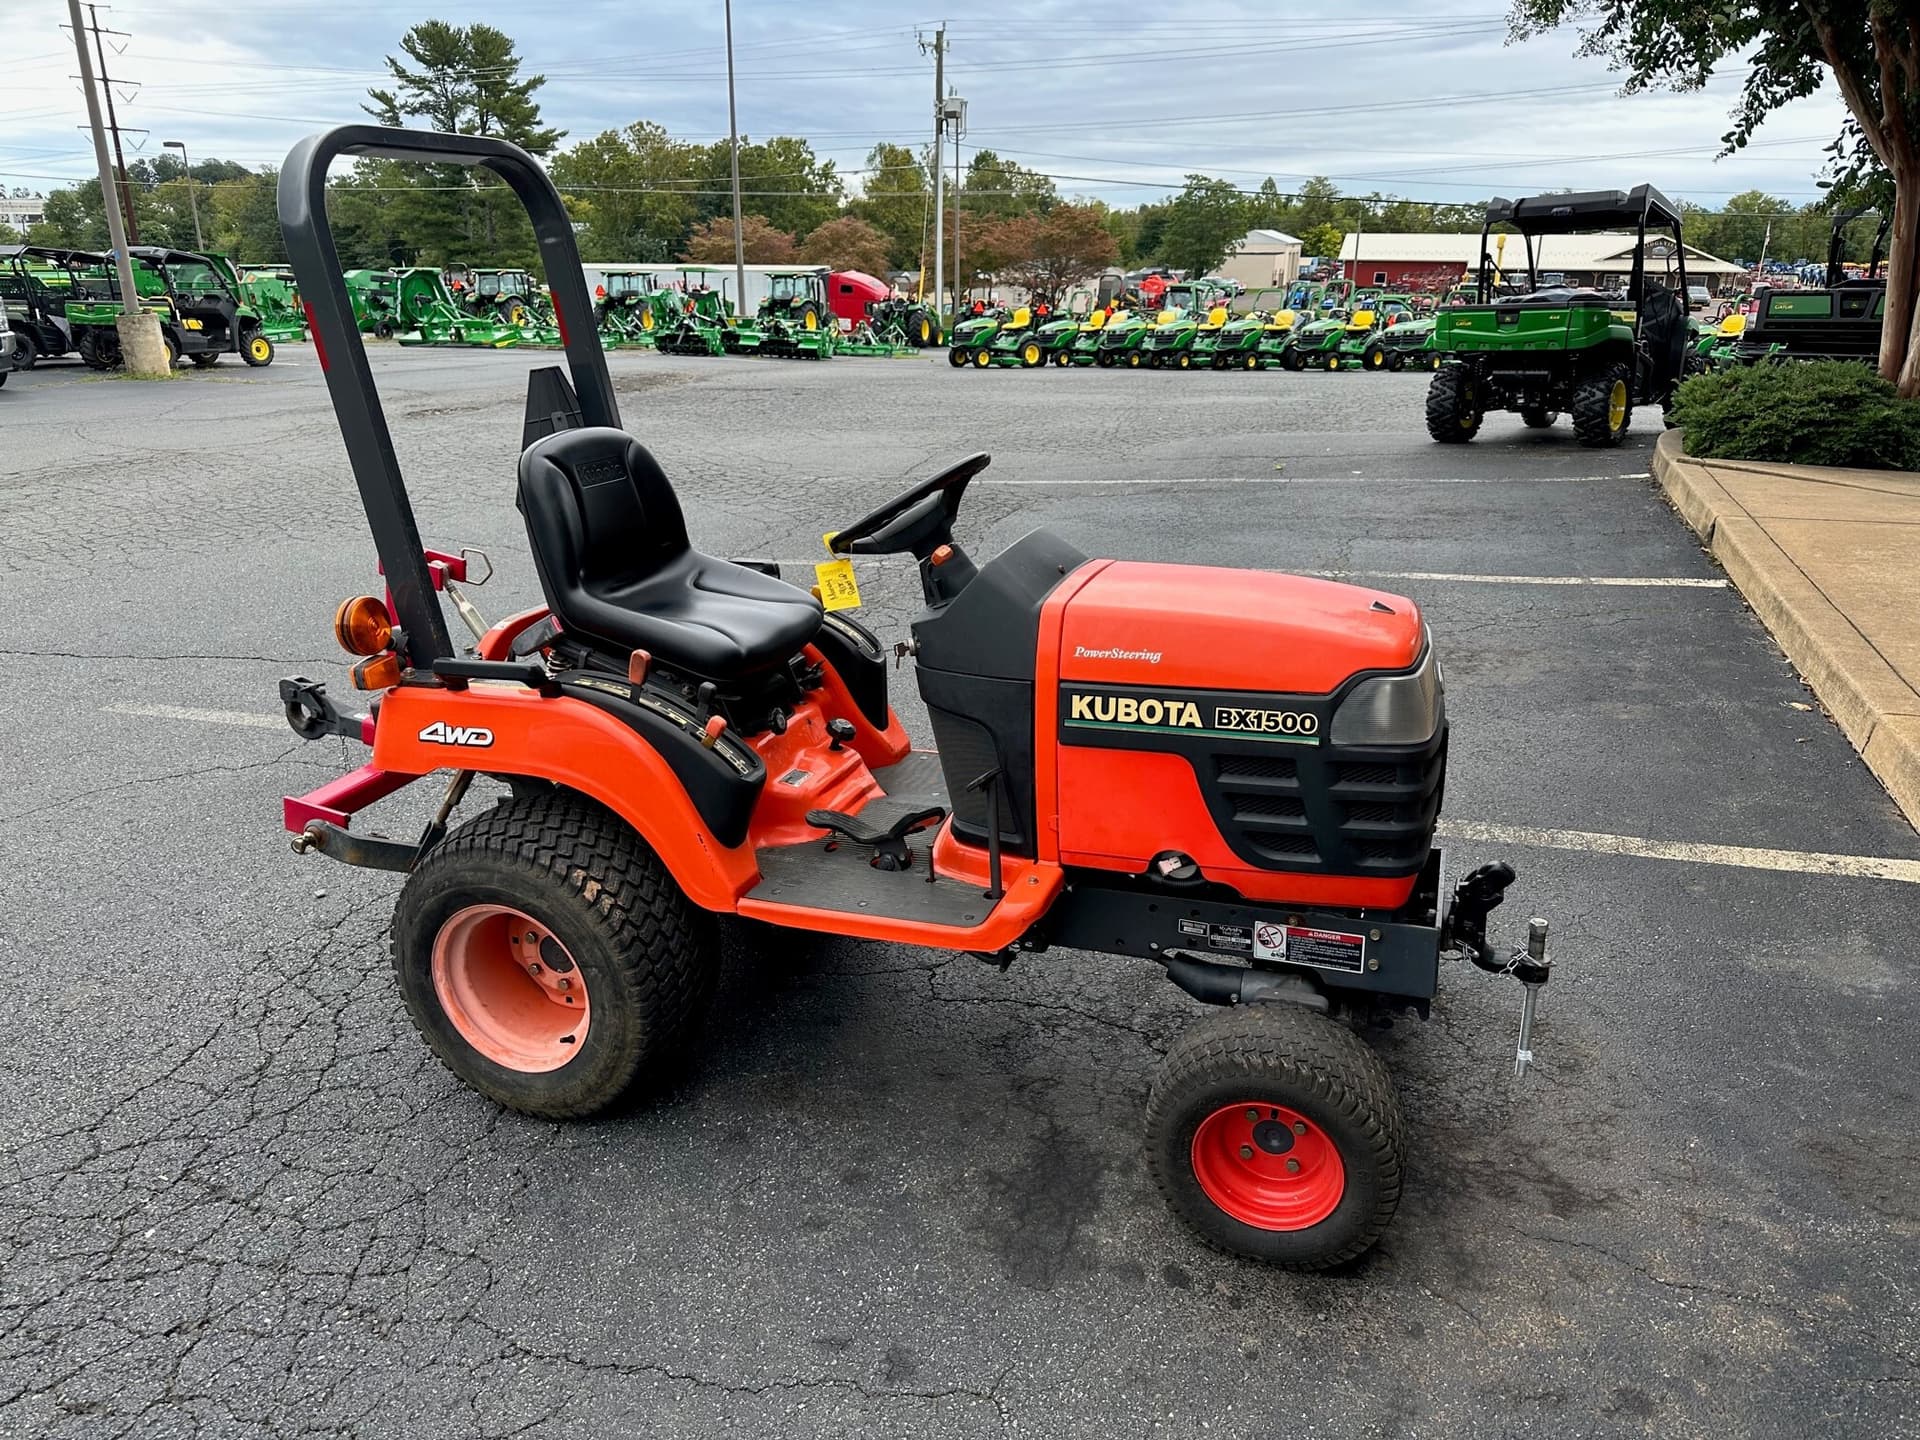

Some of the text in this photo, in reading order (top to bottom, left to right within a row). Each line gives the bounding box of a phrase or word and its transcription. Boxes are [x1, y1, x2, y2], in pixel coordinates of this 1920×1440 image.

[1073, 646, 1163, 664] PowerSteering
[1071, 694, 1319, 735] KUBOTA BX1500
[418, 721, 495, 747] 4WD
[1313, 931, 1341, 940] DANGER
